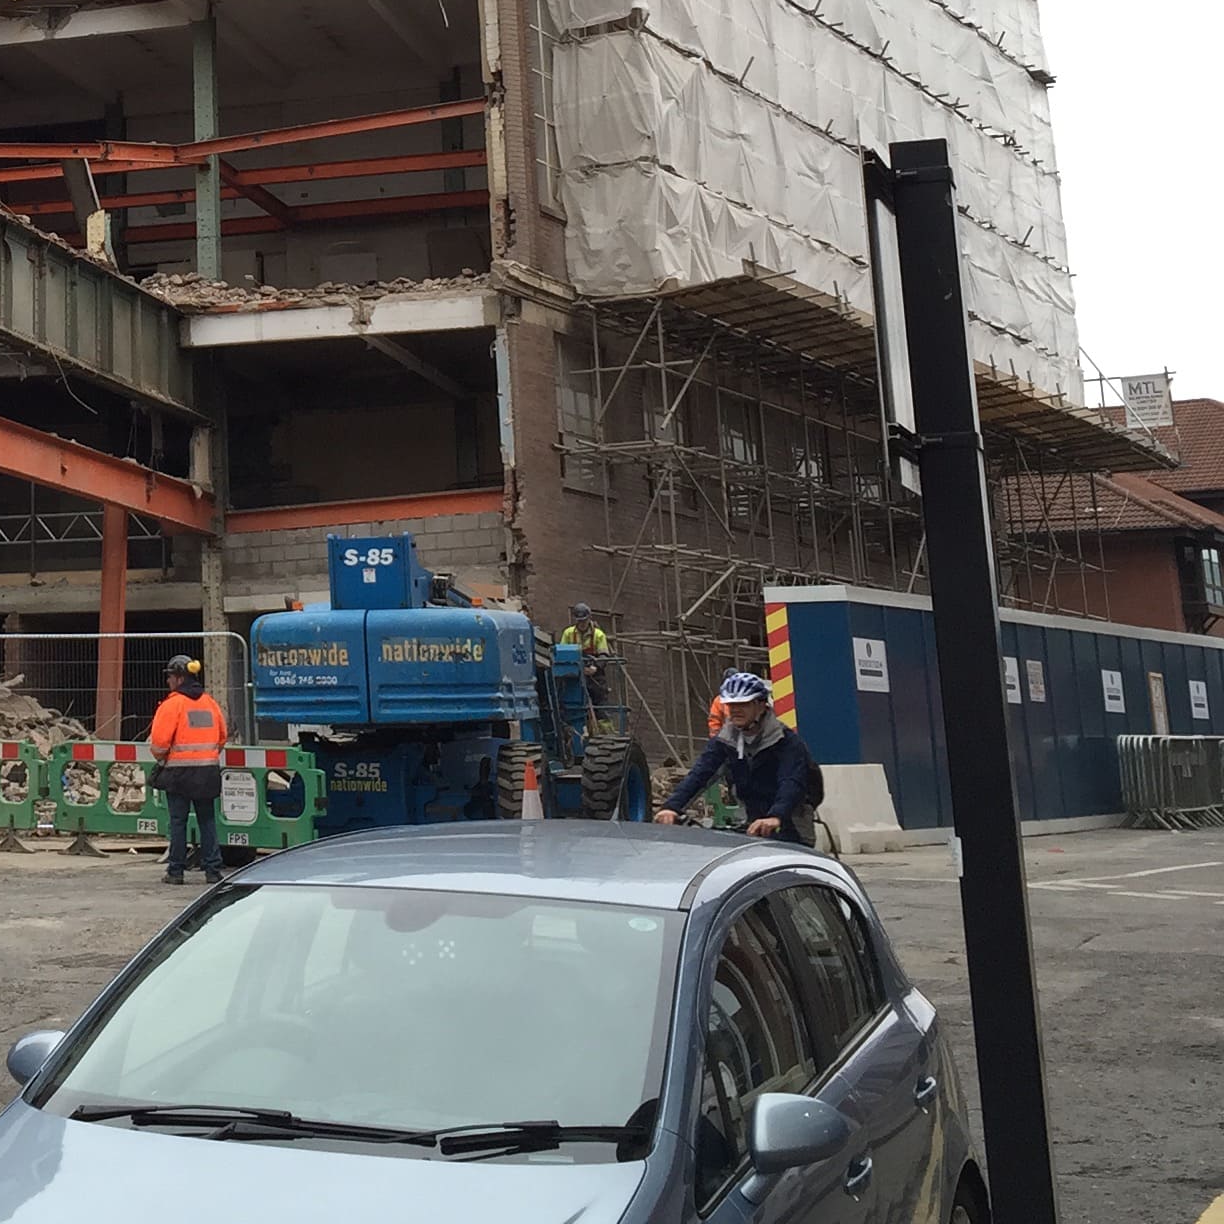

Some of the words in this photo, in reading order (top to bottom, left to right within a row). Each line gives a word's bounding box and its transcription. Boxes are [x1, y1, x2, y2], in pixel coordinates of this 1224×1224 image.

[1128, 381, 1163, 395] MTL
[343, 548, 394, 566] S-85
[381, 637, 484, 663] nationwide
[333, 762, 382, 778] S-85
[329, 778, 388, 793] nationwide
[138, 820, 157, 832] FPS
[229, 833, 248, 845] FPS
